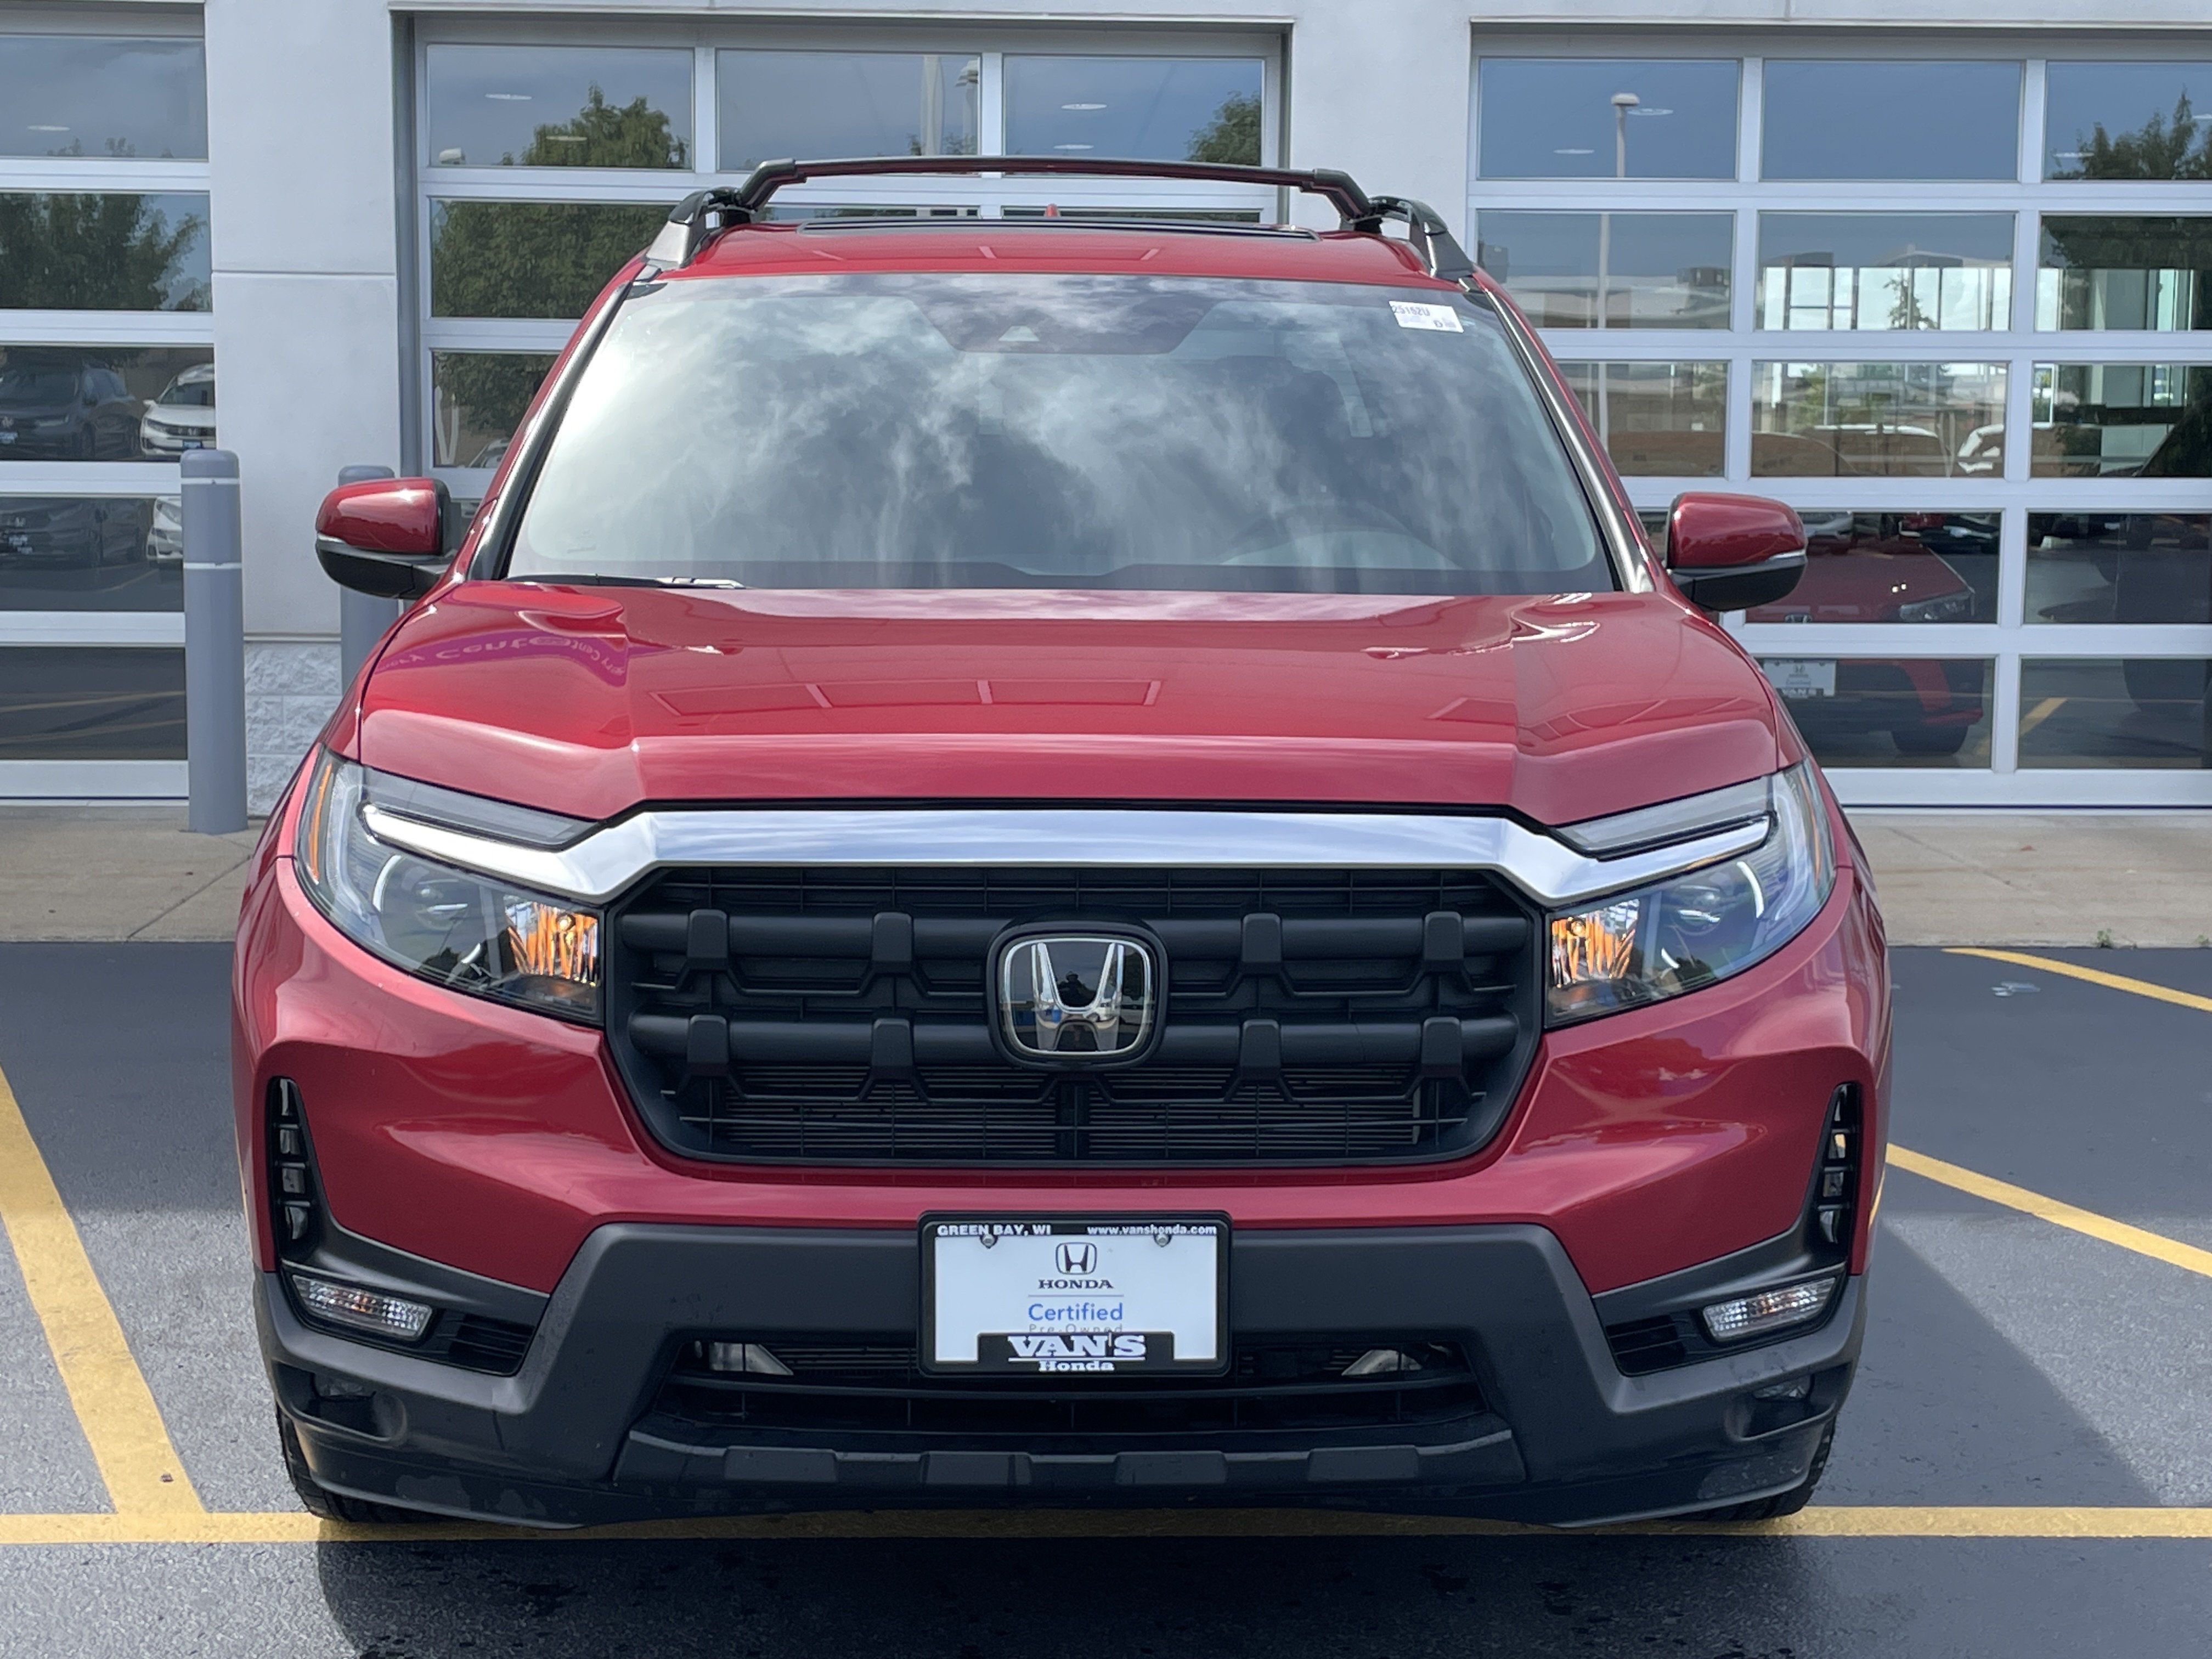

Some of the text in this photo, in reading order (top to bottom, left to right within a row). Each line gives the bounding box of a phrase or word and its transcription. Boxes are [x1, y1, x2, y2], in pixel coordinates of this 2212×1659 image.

[937, 1224, 1051, 1237] GREEN BAY, WI
[1087, 1223, 1217, 1235] www.vanshonda.com
[1039, 1279, 1114, 1289] HONDA
[1028, 1302, 1123, 1321] Certified
[1007, 1332, 1147, 1357] VAN'S
[1039, 1360, 1115, 1373] Honda
